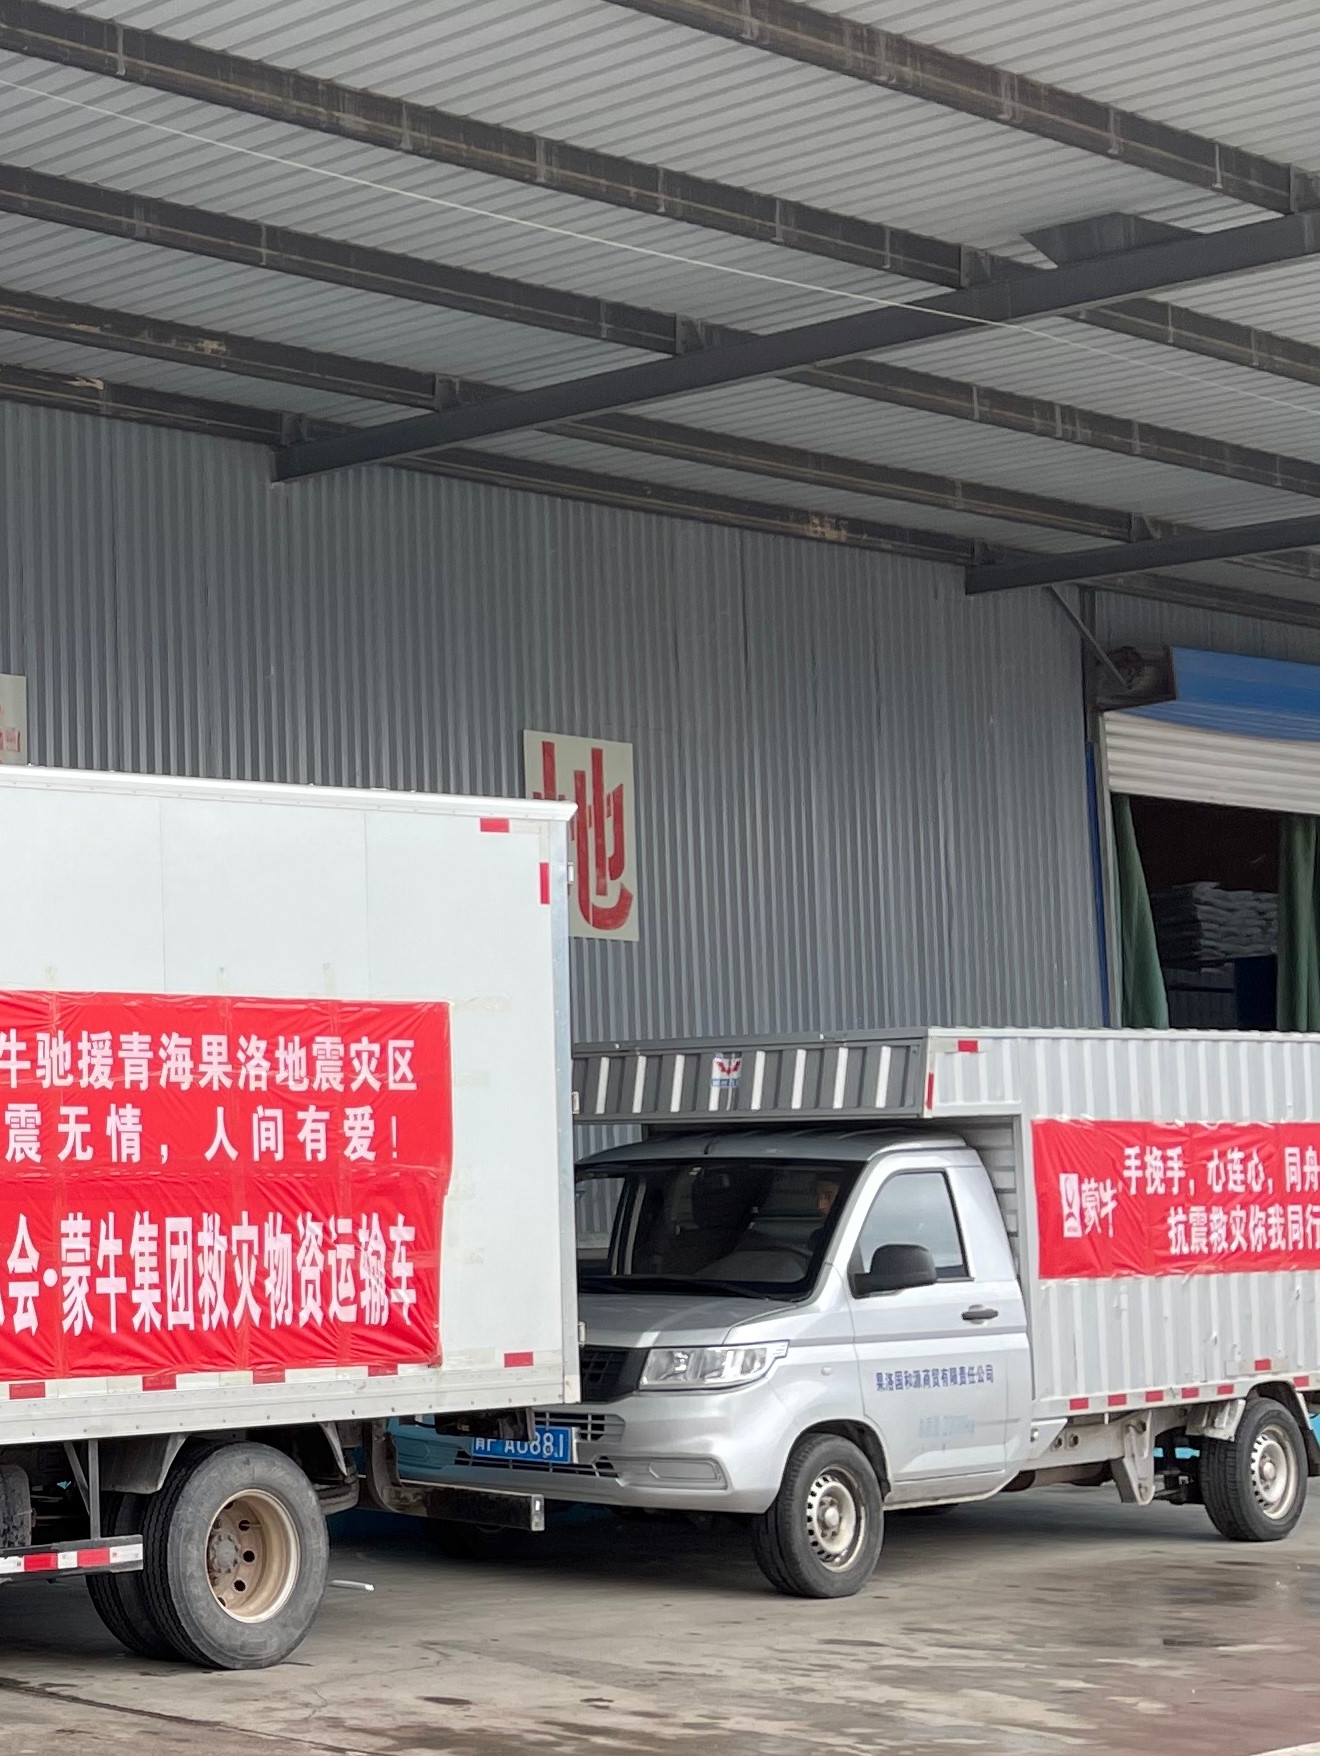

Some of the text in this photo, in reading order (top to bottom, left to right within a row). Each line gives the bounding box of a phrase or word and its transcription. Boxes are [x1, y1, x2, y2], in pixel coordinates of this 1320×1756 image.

[1081, 1177, 1118, 1238] 蒙牛
[1167, 1203, 1320, 1255] 抗震救灾你我同行
